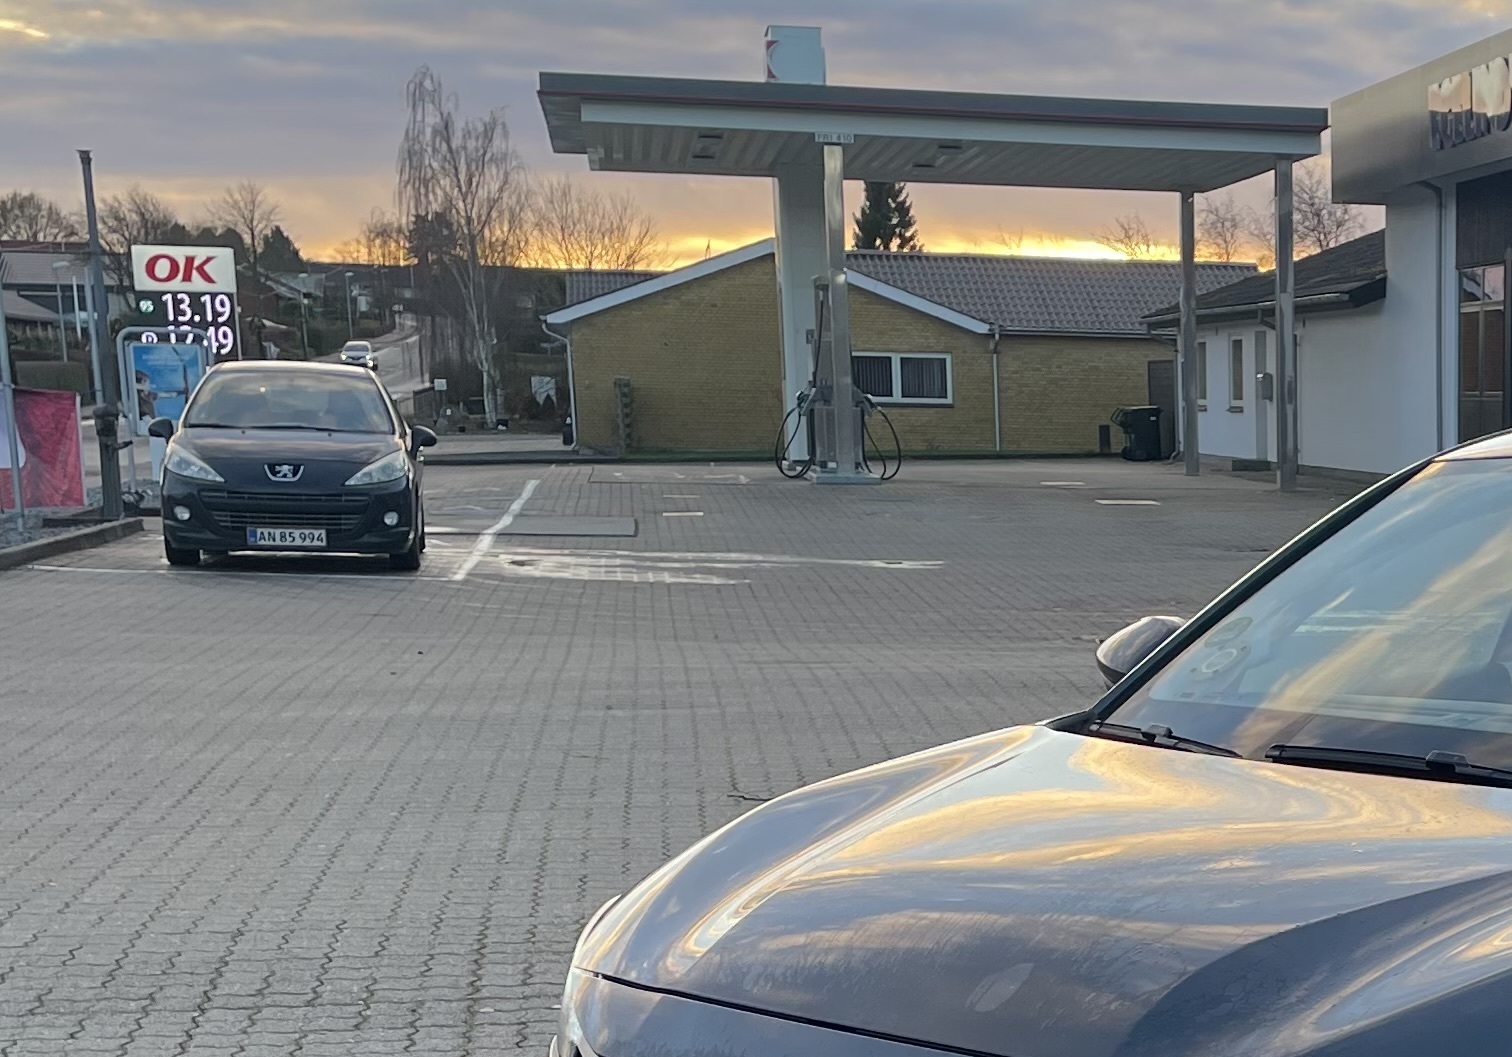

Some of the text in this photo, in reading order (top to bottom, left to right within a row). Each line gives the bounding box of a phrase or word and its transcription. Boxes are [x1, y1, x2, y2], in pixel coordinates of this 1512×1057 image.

[145, 253, 217, 284] OK
[162, 293, 231, 323] 13.19
[258, 531, 324, 544] AN 85 994
